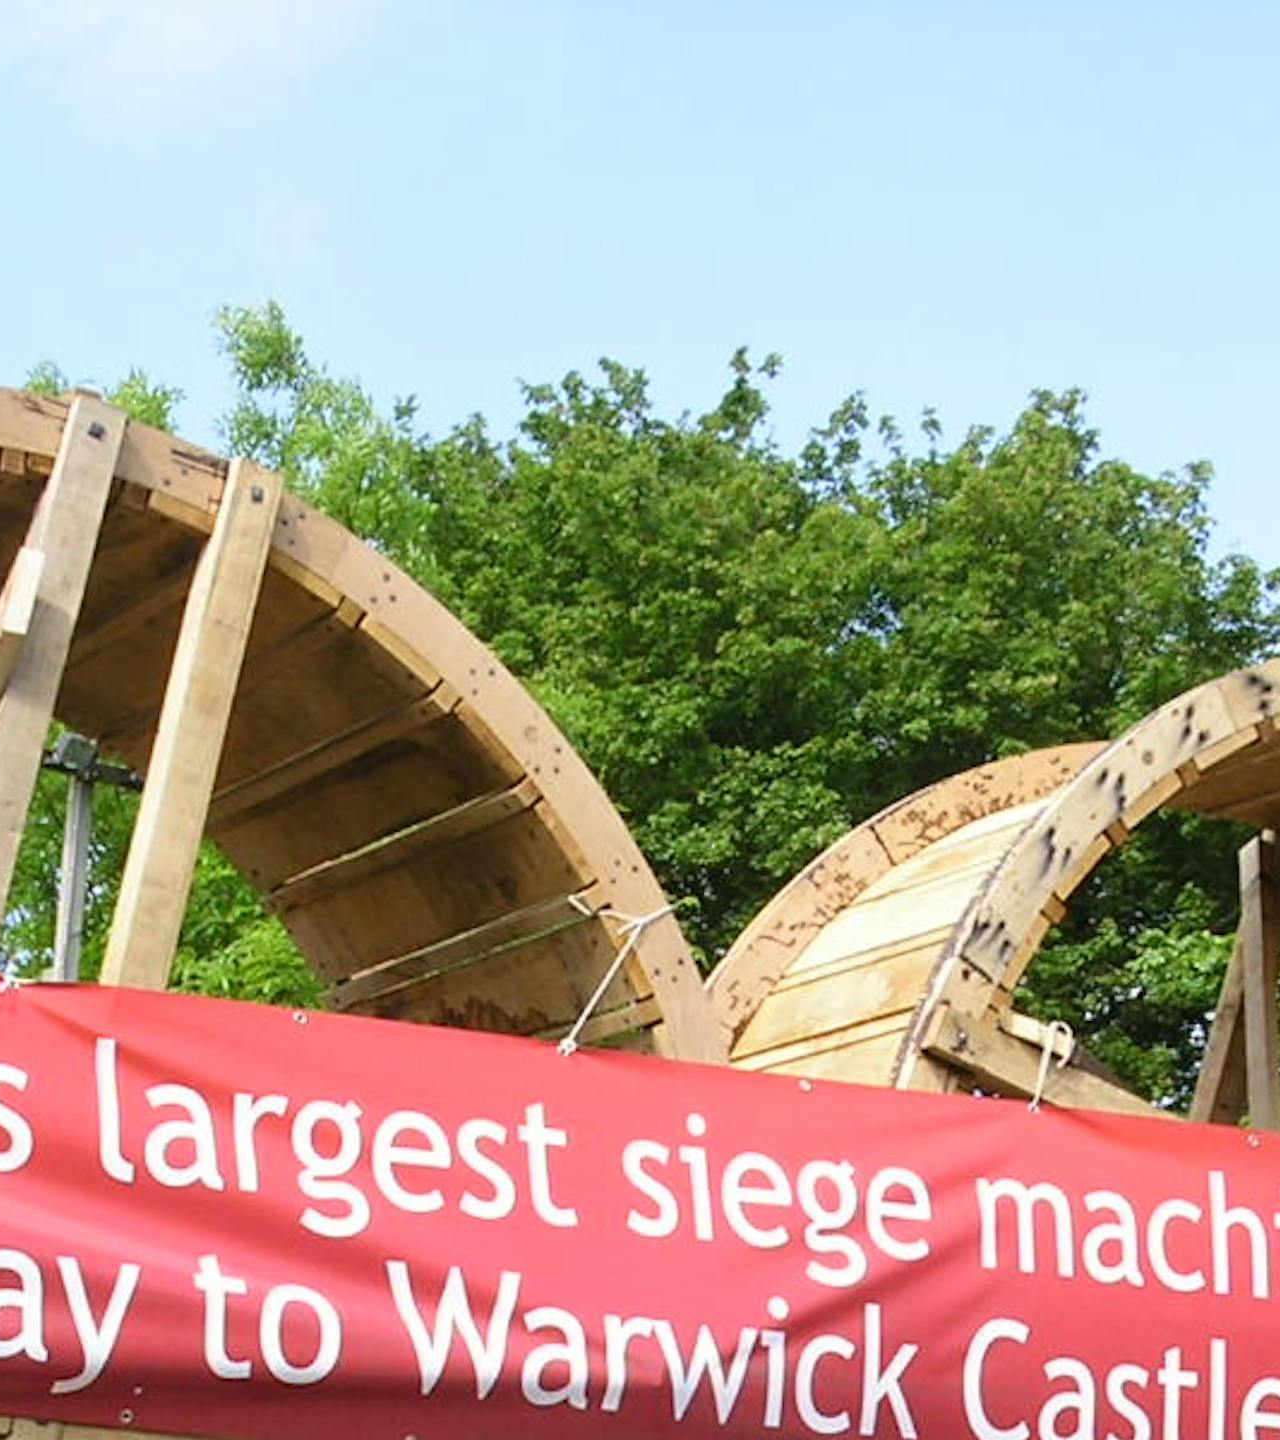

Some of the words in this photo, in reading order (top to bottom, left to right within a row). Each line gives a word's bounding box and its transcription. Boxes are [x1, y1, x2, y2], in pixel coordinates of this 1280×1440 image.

[96, 1038, 579, 1238] largest
[622, 1113, 933, 1287] siege
[194, 1254, 342, 1383] to
[386, 1260, 918, 1440] Warwick
